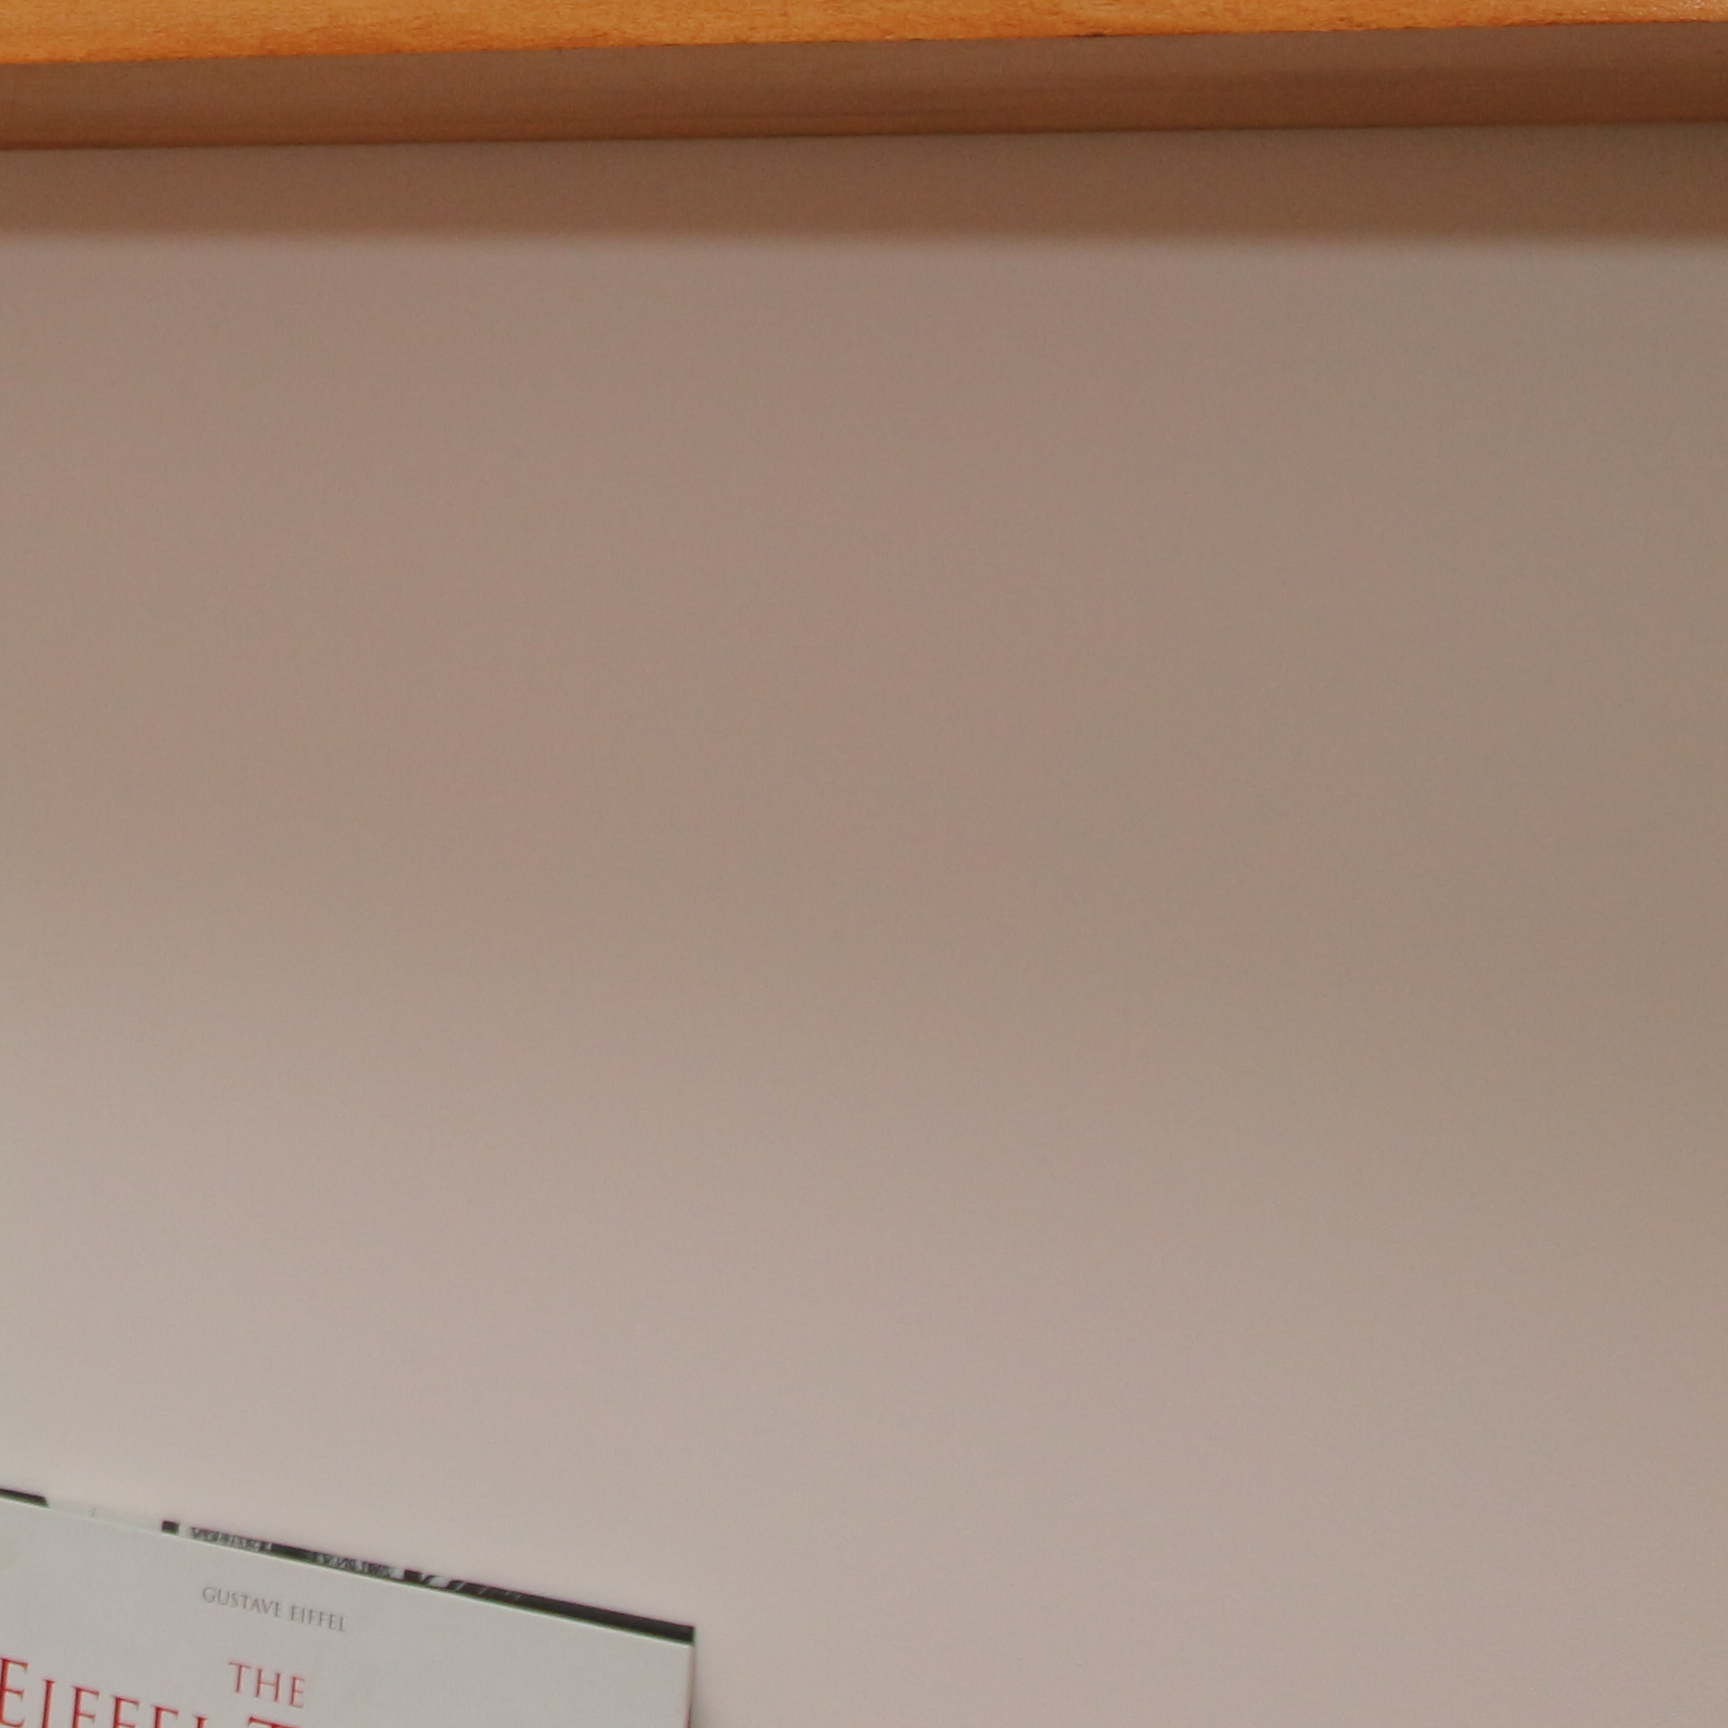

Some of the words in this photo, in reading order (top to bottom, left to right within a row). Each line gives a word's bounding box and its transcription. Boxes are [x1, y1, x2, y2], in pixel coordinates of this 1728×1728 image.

[202, 1586, 282, 1619] GUSTAVE
[290, 1605, 347, 1633] EIFFEL
[228, 1660, 307, 1709] THE
